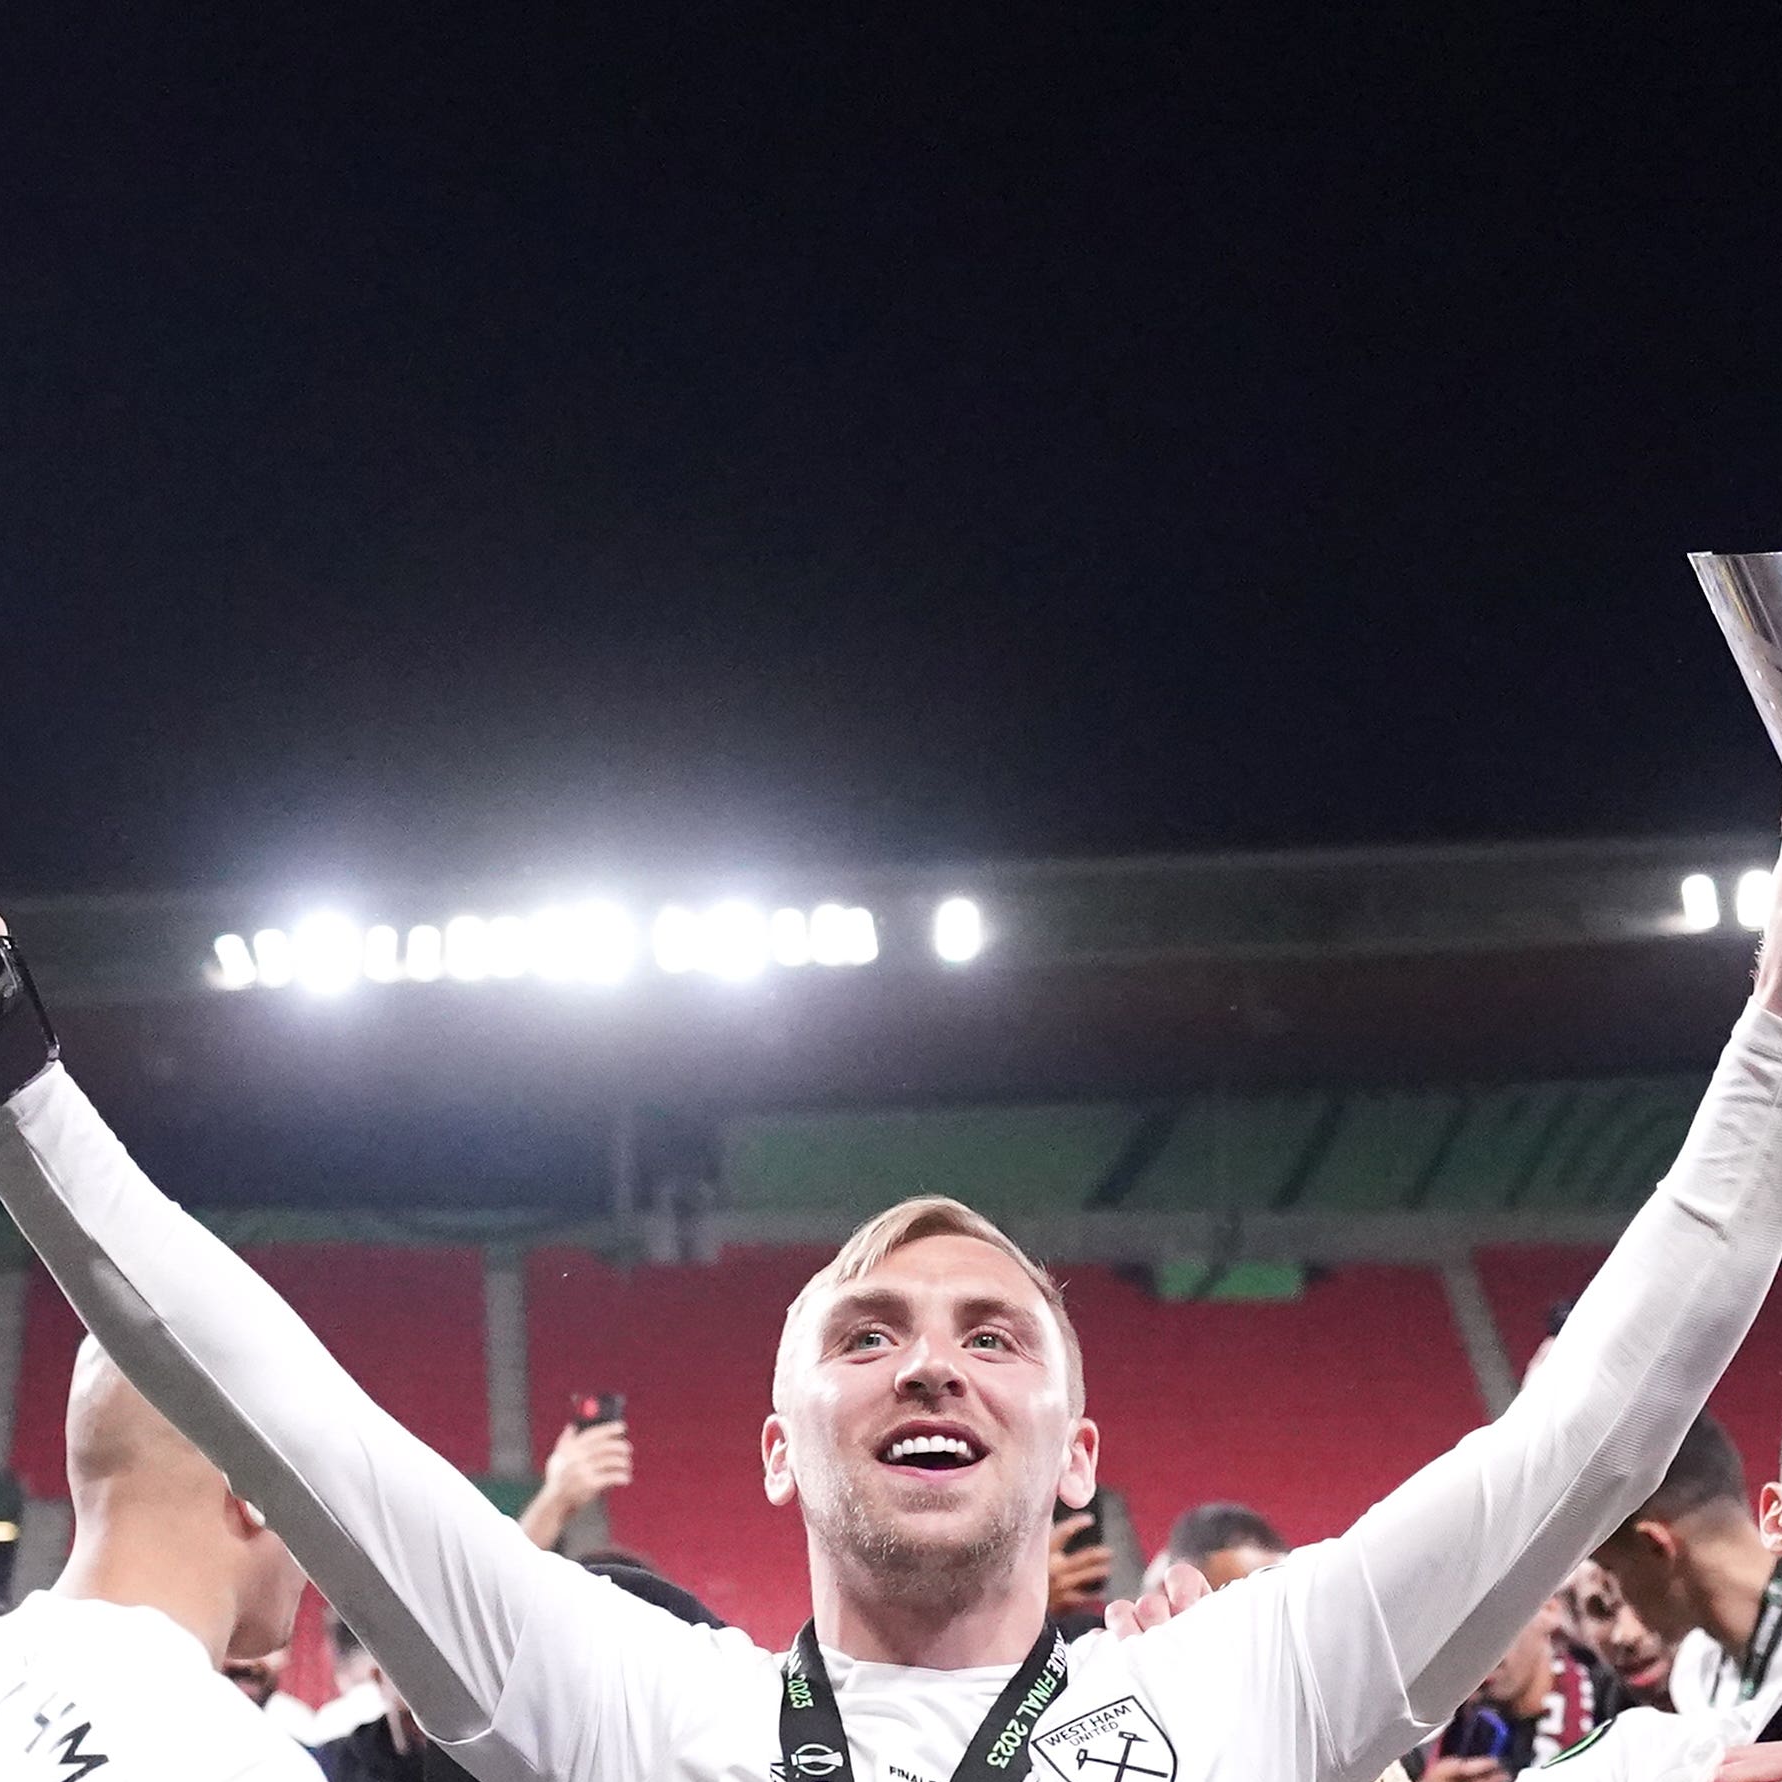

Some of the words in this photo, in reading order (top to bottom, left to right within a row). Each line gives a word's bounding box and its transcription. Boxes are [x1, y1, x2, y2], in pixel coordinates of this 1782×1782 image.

[1015, 1669, 1058, 1718] FINAL
[986, 1719, 1029, 1769] 2023
[1045, 1721, 1087, 1747] WEST
[1089, 1704, 1132, 1727] HAM
[1069, 1720, 1119, 1747] UNITED
